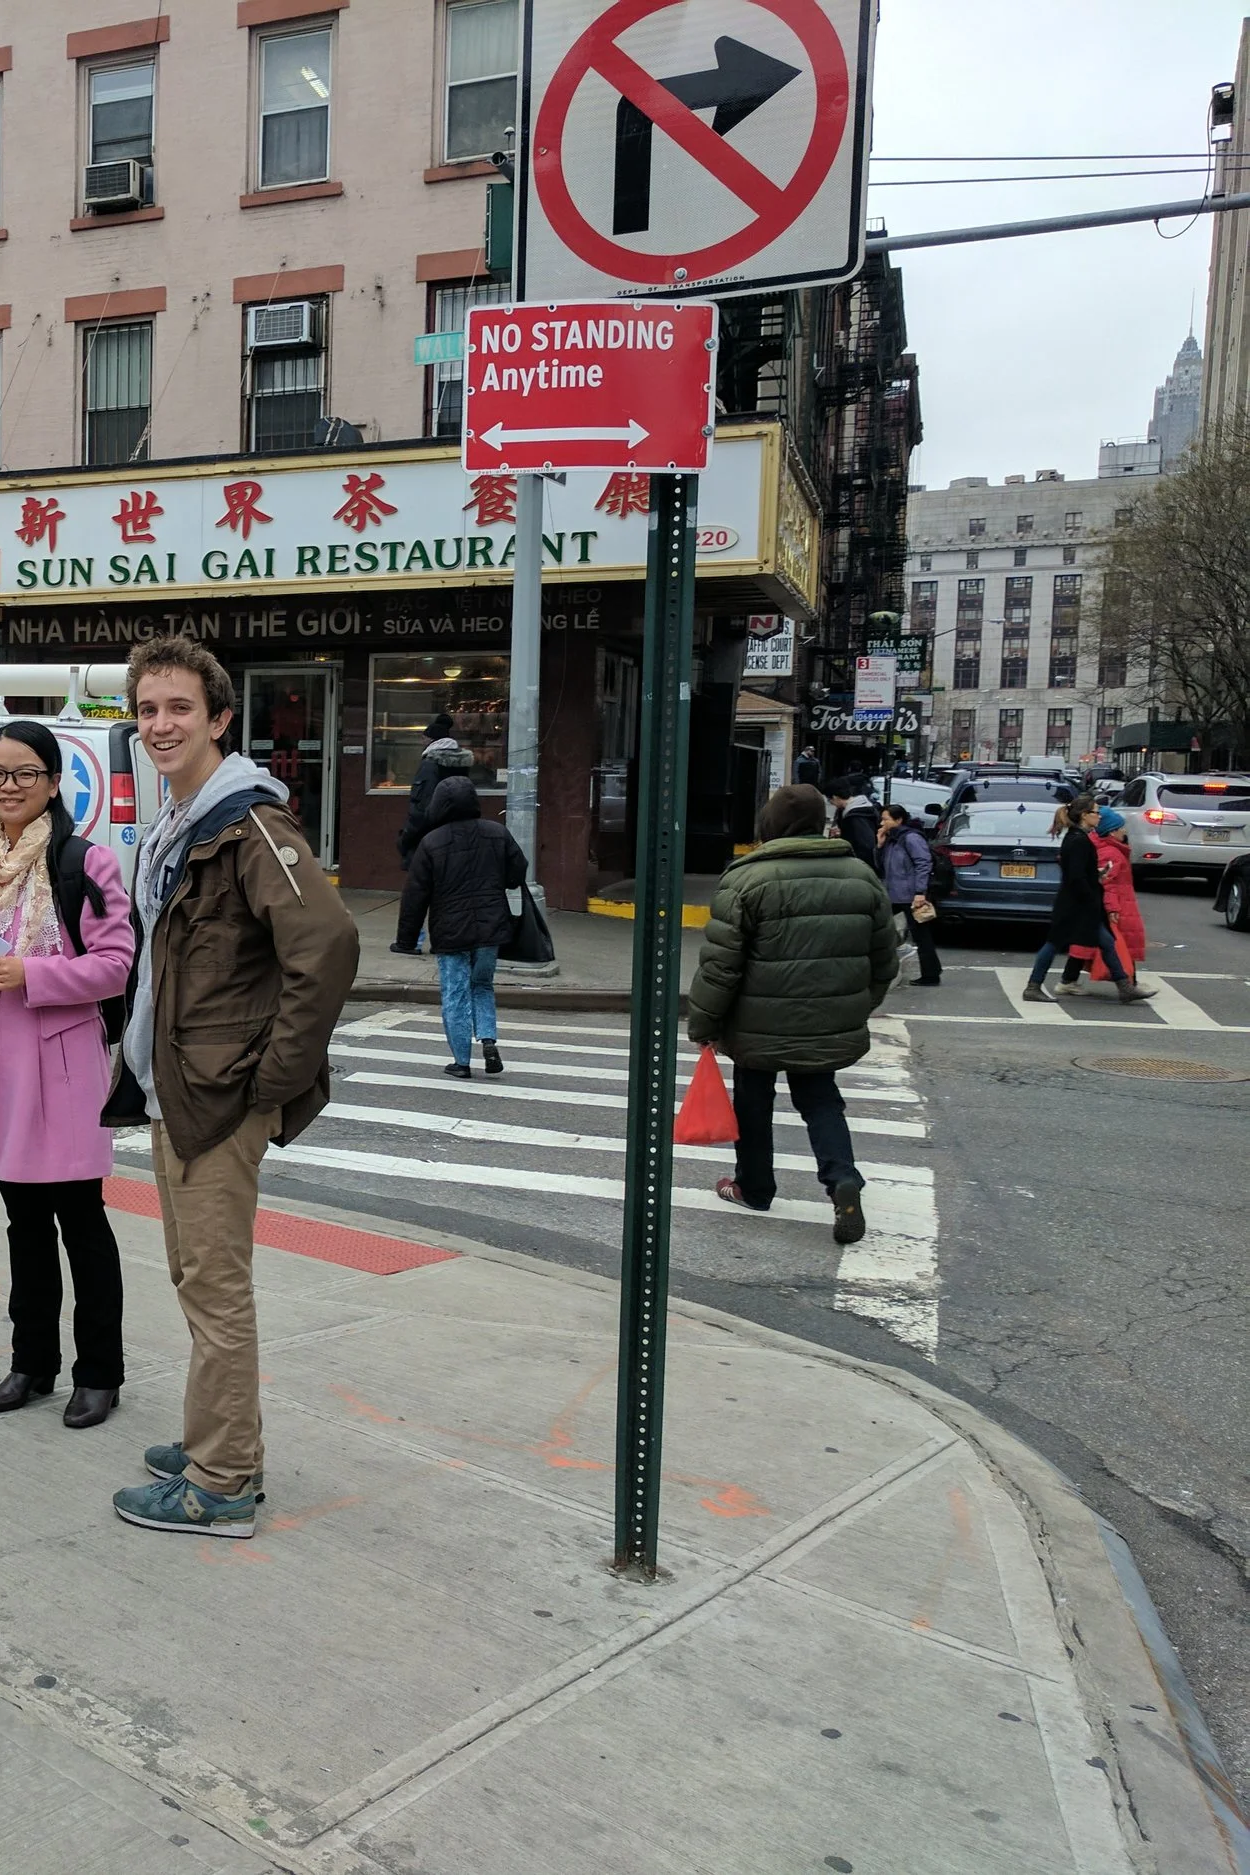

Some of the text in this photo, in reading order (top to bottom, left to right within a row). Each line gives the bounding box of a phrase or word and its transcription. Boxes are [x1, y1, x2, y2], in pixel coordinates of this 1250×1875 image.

[616, 288, 639, 296] DEPT
[668, 275, 745, 290] TRANSPORTATION
[481, 319, 675, 353] NO STANDING
[481, 359, 603, 397] Anytime
[16, 557, 94, 588] SUN
[108, 552, 176, 585] SAI
[202, 548, 276, 581] GAI
[428, 613, 456, 634] VÀ
[461, 616, 504, 633] HEO
[770, 637, 792, 652] COURT
[771, 655, 791, 669] DEPT.
[859, 659, 867, 669] 3
[123, 829, 136, 843] 33
